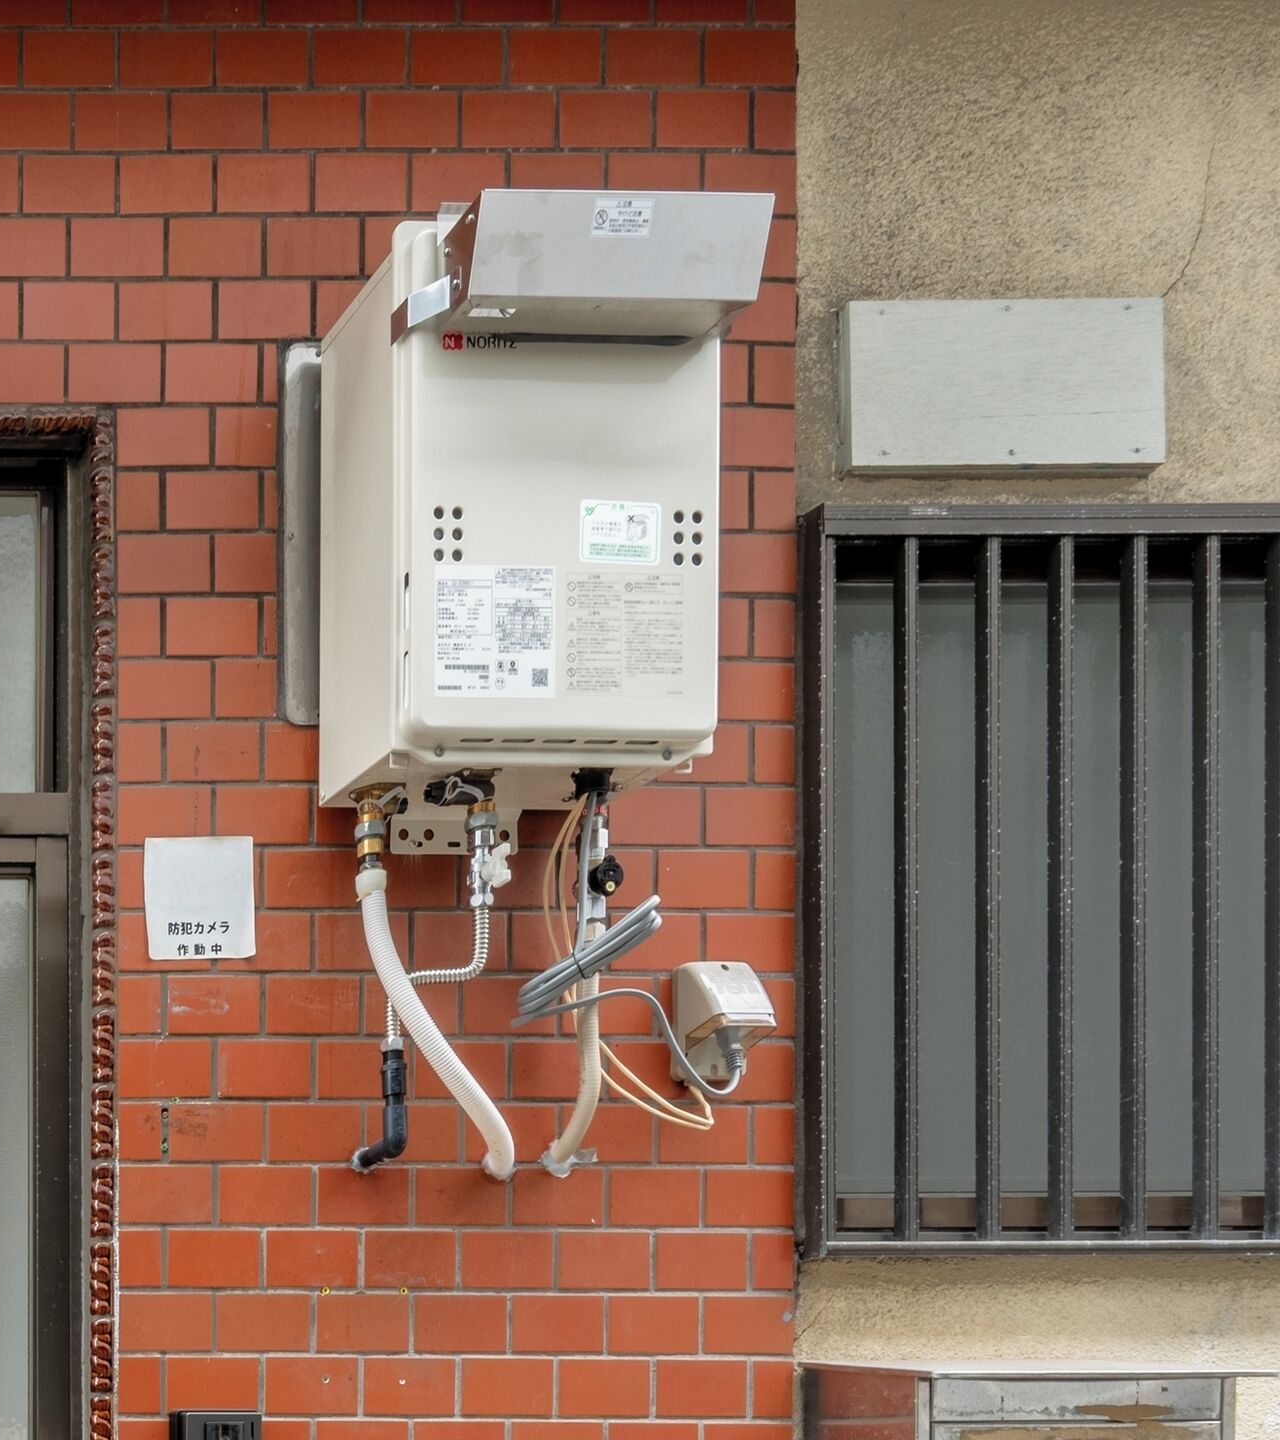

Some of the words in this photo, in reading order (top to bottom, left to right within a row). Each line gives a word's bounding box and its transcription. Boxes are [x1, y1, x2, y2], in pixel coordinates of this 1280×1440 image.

[168, 921, 230, 935] 防犯カメラ
[177, 943, 223, 956] 作動中
